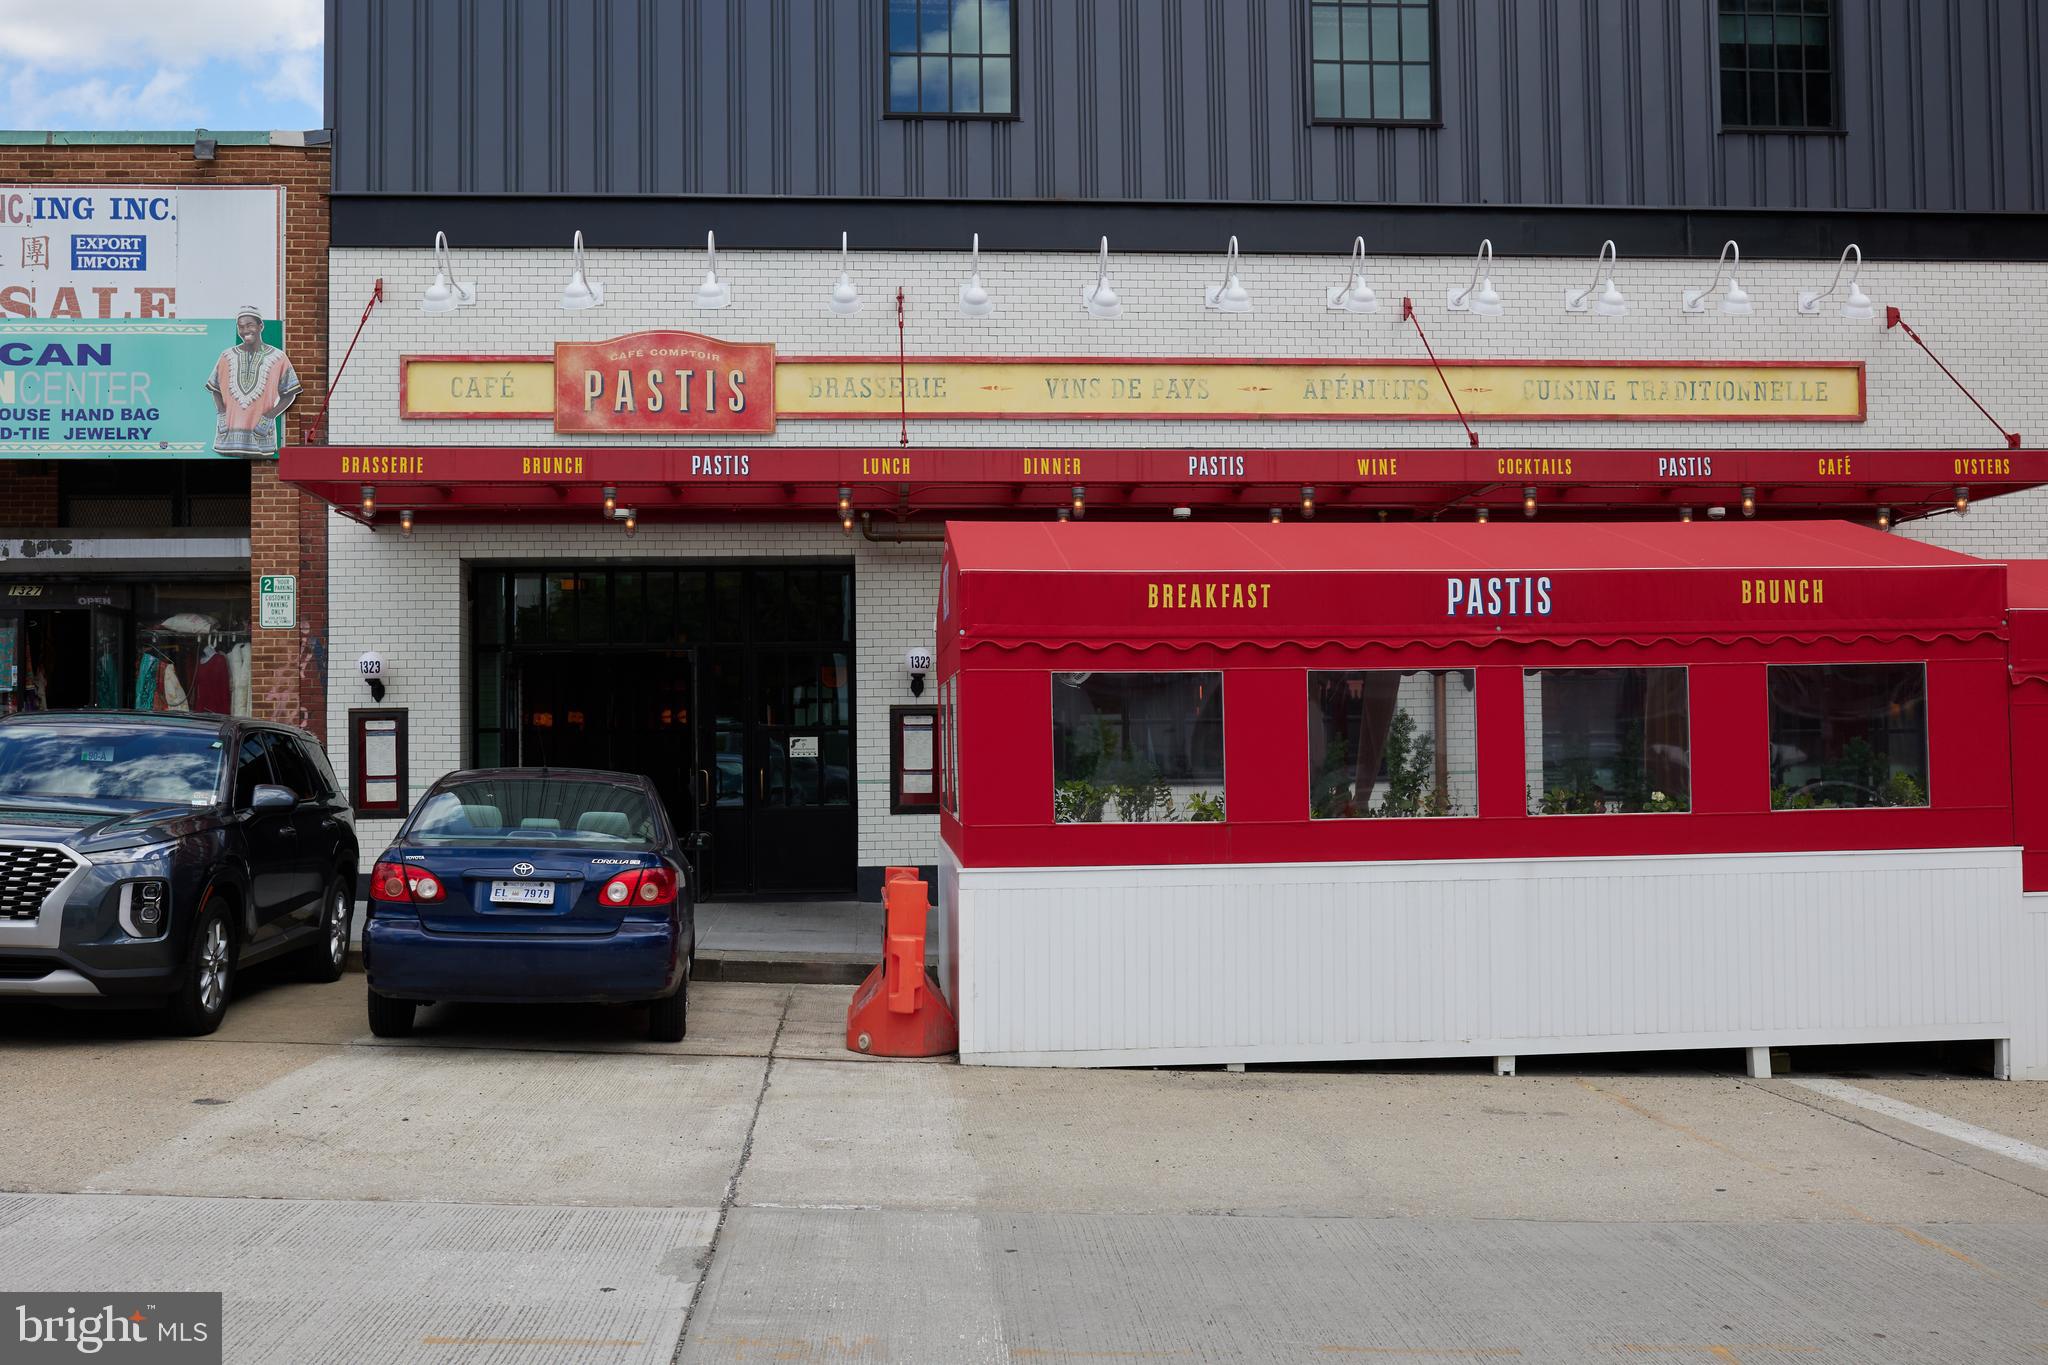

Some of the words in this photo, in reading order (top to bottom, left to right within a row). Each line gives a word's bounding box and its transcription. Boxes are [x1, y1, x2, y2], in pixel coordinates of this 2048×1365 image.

[0, 194, 31, 223] C.
[33, 197, 95, 220] ING
[109, 197, 177, 221] INC.
[76, 237, 142, 250] EXPORT
[77, 256, 140, 269] IMPORT
[0, 285, 176, 319] SALE
[0, 342, 112, 366] CAN
[610, 348, 645, 361] CAFÉ
[650, 348, 720, 362] COMPTOIR
[451, 371, 515, 399] CAFÉ
[583, 369, 748, 414] PASTIS
[808, 376, 948, 399] BRASSERIE
[1045, 377, 1101, 400] VINS
[1111, 377, 1142, 400] DE
[1151, 378, 1210, 401] PAYS
[1302, 373, 1430, 401] APÉRITIFS
[1522, 379, 1617, 402] CUISINE
[1627, 380, 1829, 403] TRADITIONNELLE
[0, 408, 51, 422] OUSE
[61, 408, 115, 422] HAND
[120, 408, 160, 422] BAG
[0, 427, 50, 440] D-TIE
[63, 427, 153, 441] JEWELRY
[341, 456, 424, 474] BRASSERIE
[522, 457, 584, 475] BRUNCH
[691, 455, 751, 476] PASTIS
[862, 457, 911, 475] LUNCH
[1023, 457, 1082, 476] DINNER
[1188, 455, 1245, 476] PASTIS
[1356, 458, 1398, 476] WINE
[1497, 458, 1573, 476] COCKTAILS
[1658, 456, 1712, 477] PASTIS
[1818, 455, 1852, 476] CAFÉ
[1954, 458, 2011, 476] OYSTERS
[264, 579, 272, 591] 2
[1740, 579, 1825, 605] BRUNCH
[78, 597, 111, 606] OPEN
[1147, 583, 1272, 610] BREAKFAST
[1446, 576, 1553, 617] PASTIS
[359, 660, 381, 674] 1323
[910, 656, 931, 669] 1323
[494, 888, 507, 897] EL
[523, 888, 550, 899] 7979
